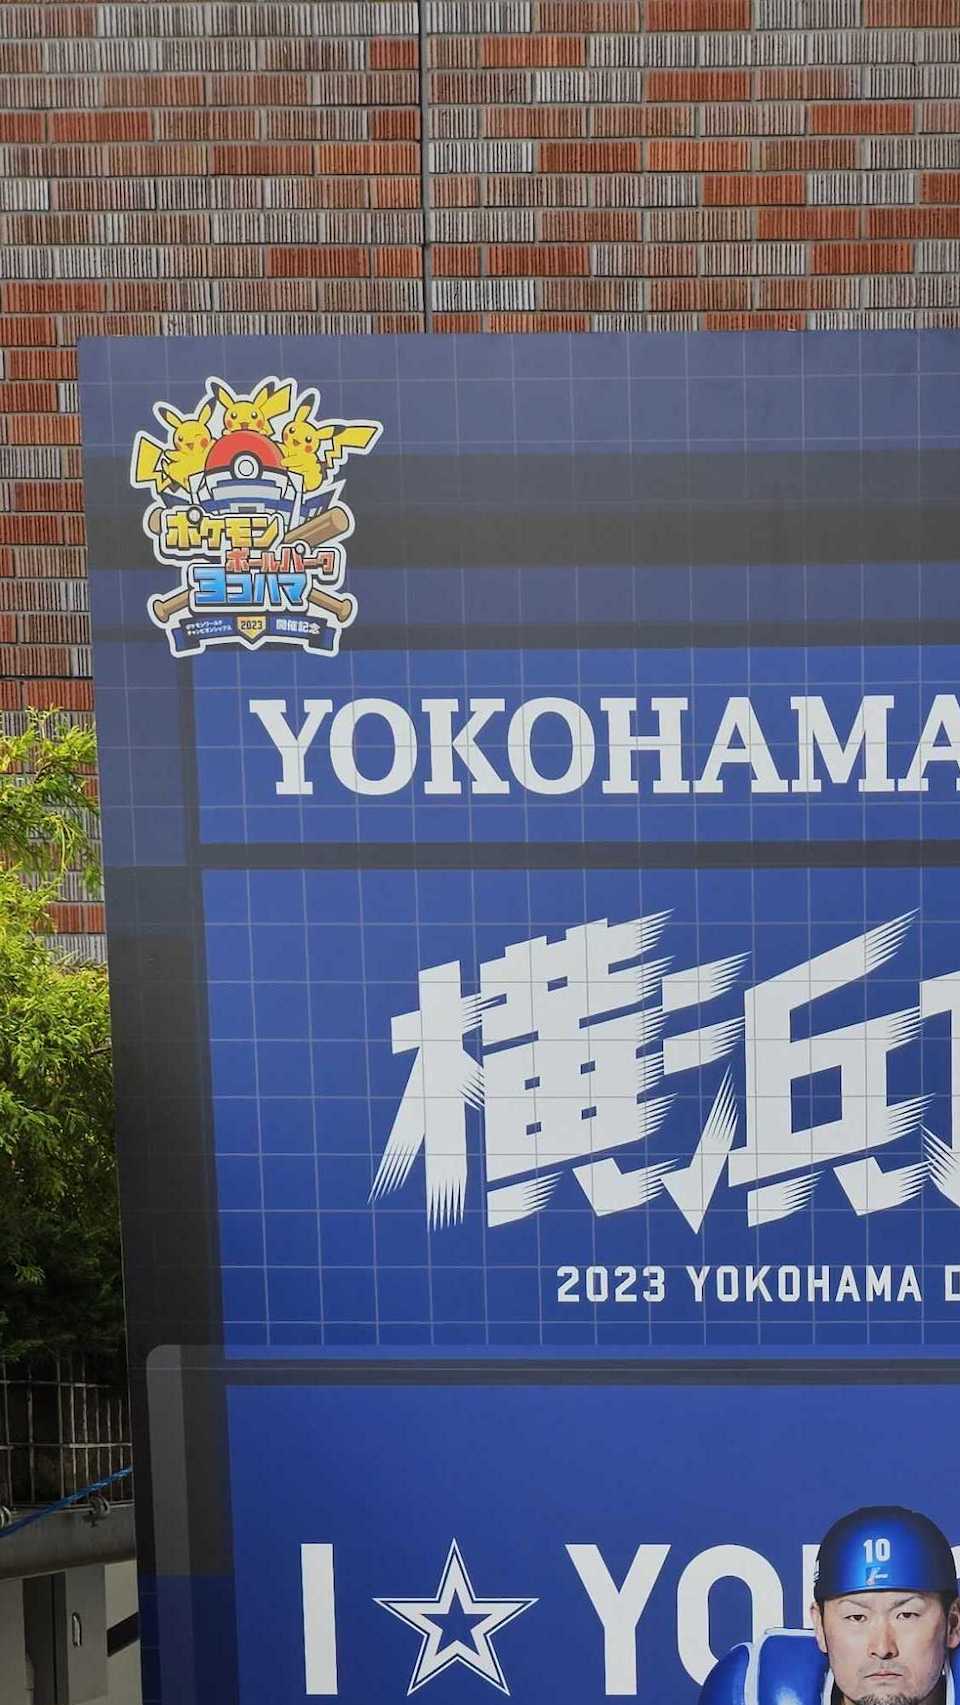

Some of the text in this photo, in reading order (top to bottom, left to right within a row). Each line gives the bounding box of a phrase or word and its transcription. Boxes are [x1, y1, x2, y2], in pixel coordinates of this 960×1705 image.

[165, 511, 280, 551] ポケモン
[224, 545, 336, 575] ボールパーク
[192, 566, 307, 605] ヨコハマ
[240, 620, 263, 630] 2023
[557, 1265, 666, 1302] 2023
[686, 1265, 922, 1302] YOKOHAMA
[863, 1538, 891, 1563] 10
[300, 1543, 338, 1696] I
